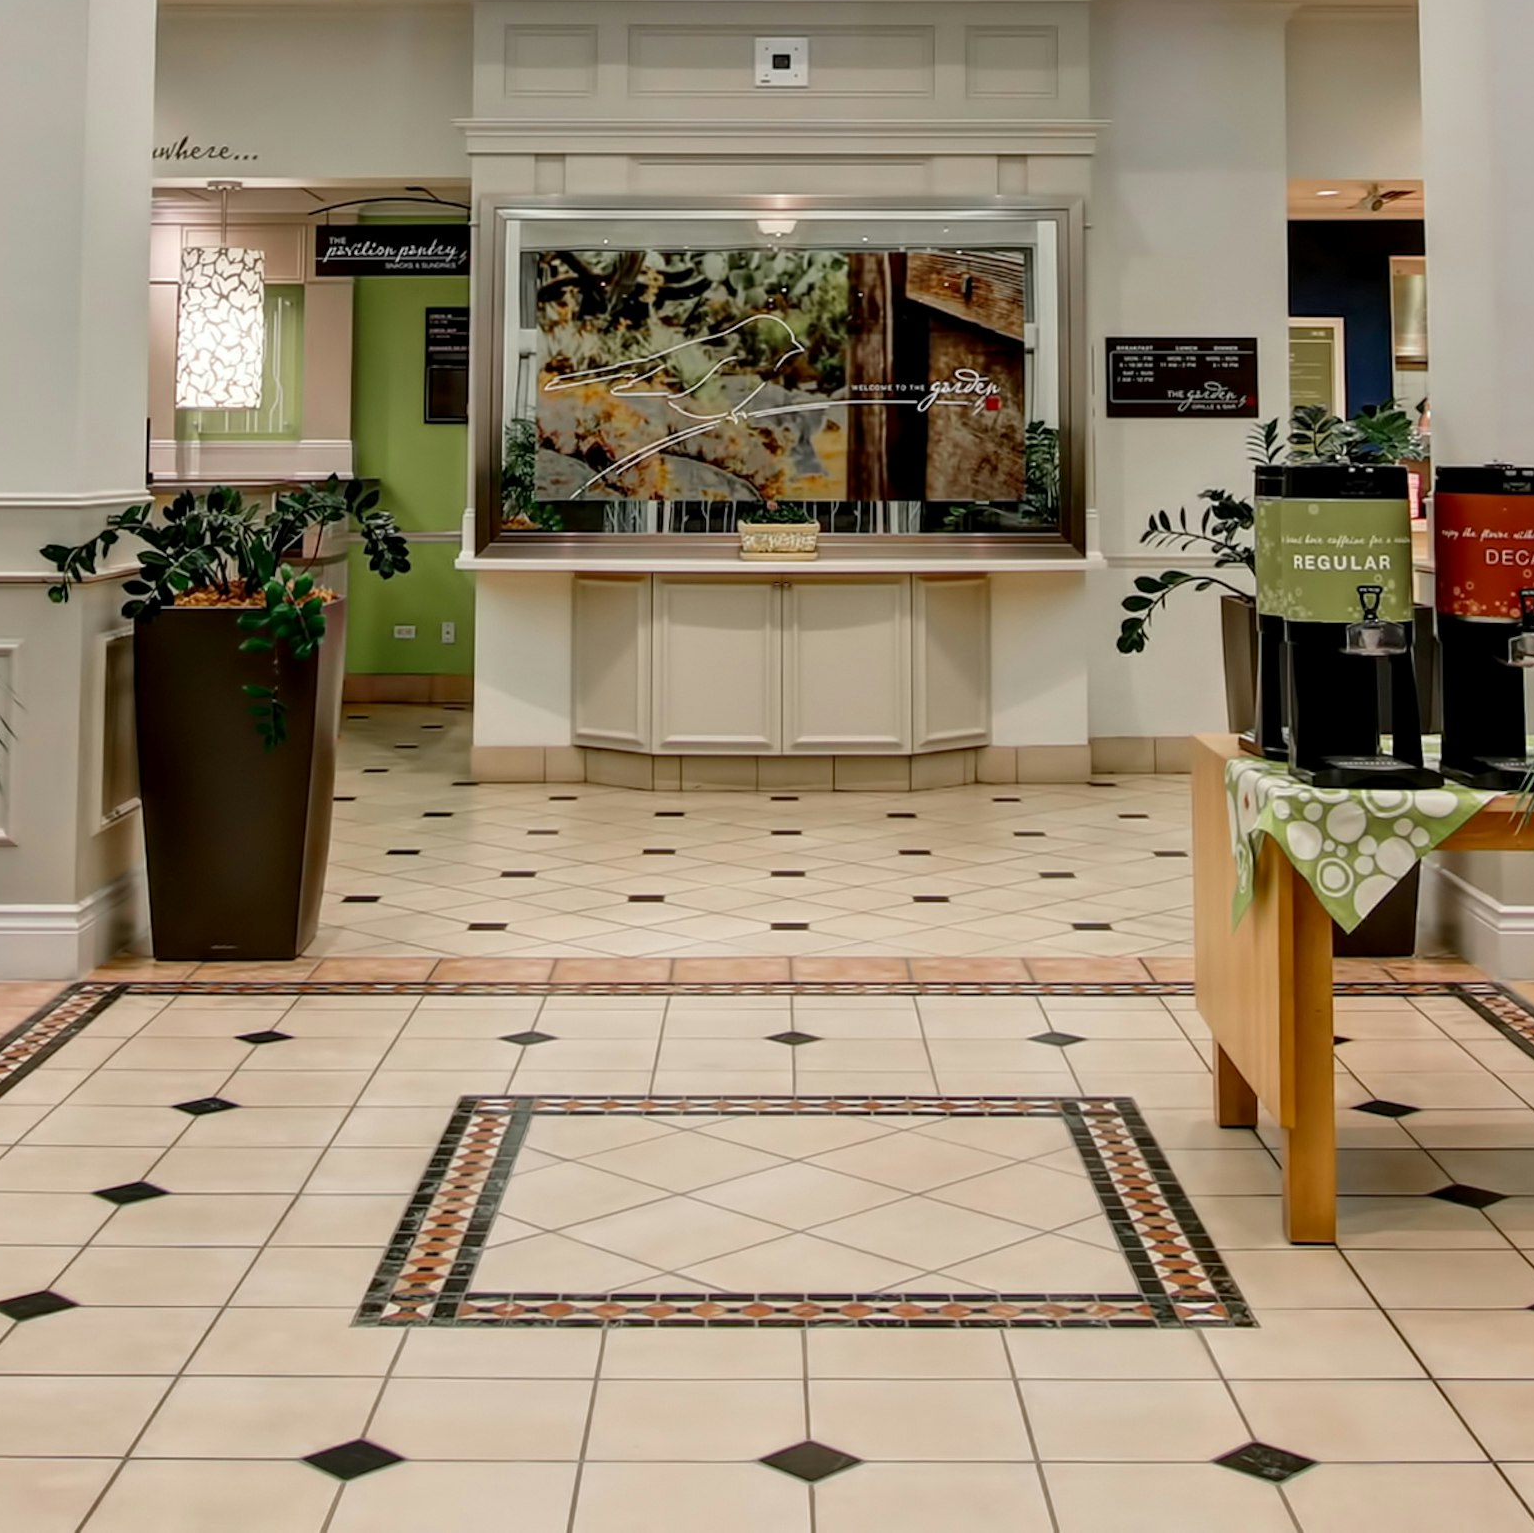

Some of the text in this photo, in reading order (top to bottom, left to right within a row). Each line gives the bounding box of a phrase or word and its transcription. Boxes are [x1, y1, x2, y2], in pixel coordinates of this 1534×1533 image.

[322, 239, 459, 263] pavilion pantry
[328, 236, 346, 245] THE
[851, 368, 1001, 413] WELCOME TO THE garden
[1167, 381, 1237, 412] THE garden
[1293, 554, 1391, 571] REGULAR
